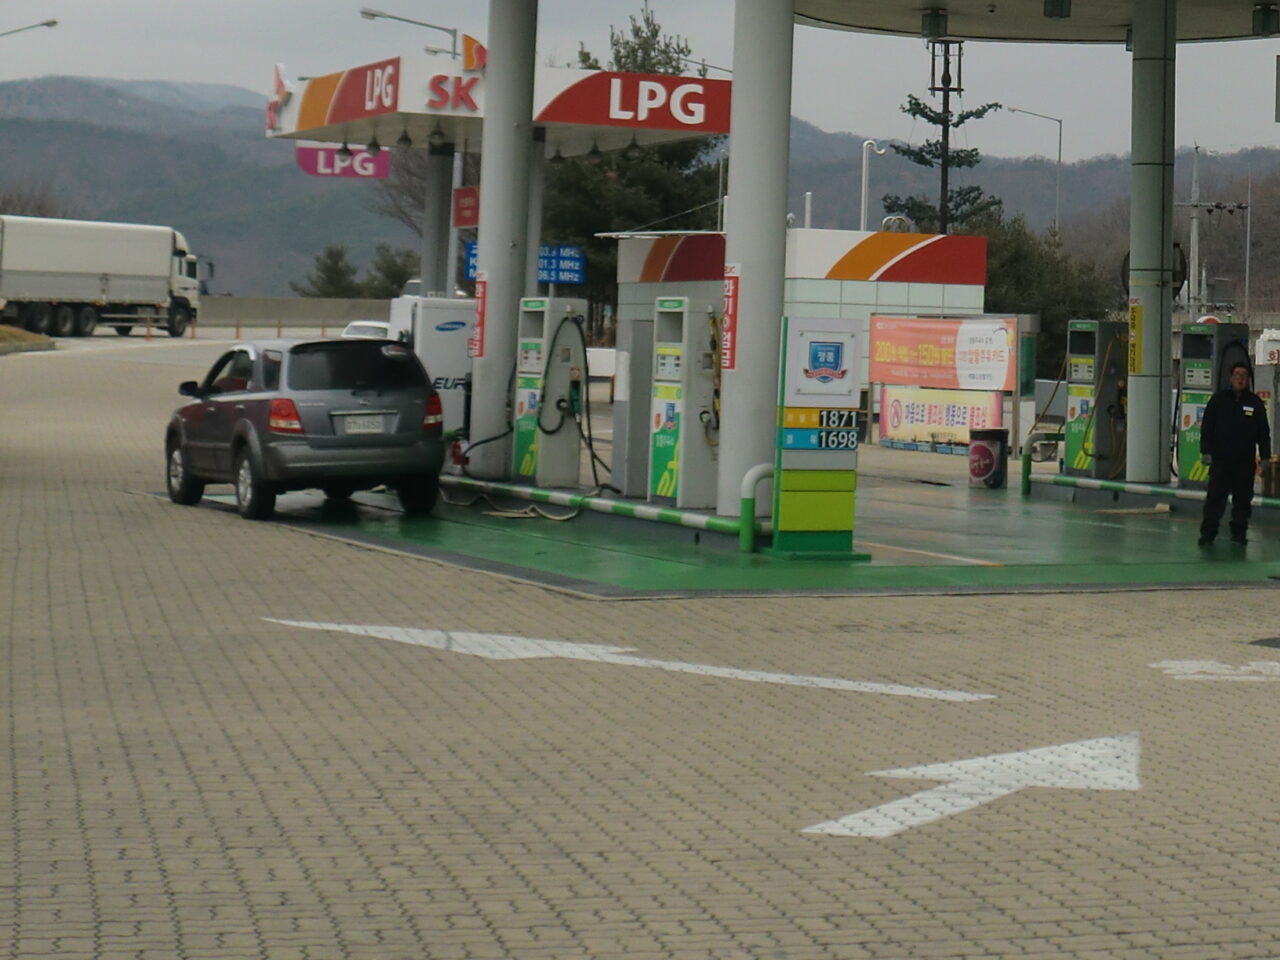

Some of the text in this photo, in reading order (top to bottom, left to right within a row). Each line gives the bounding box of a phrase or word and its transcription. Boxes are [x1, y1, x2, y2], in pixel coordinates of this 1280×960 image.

[365, 65, 394, 111] LPG
[427, 75, 480, 111] SK
[608, 78, 705, 125] LPG
[317, 150, 375, 176] LPG
[559, 259, 580, 270] MHz
[559, 271, 580, 281] MHz
[821, 411, 857, 428] 1871
[820, 431, 858, 449] 1698
